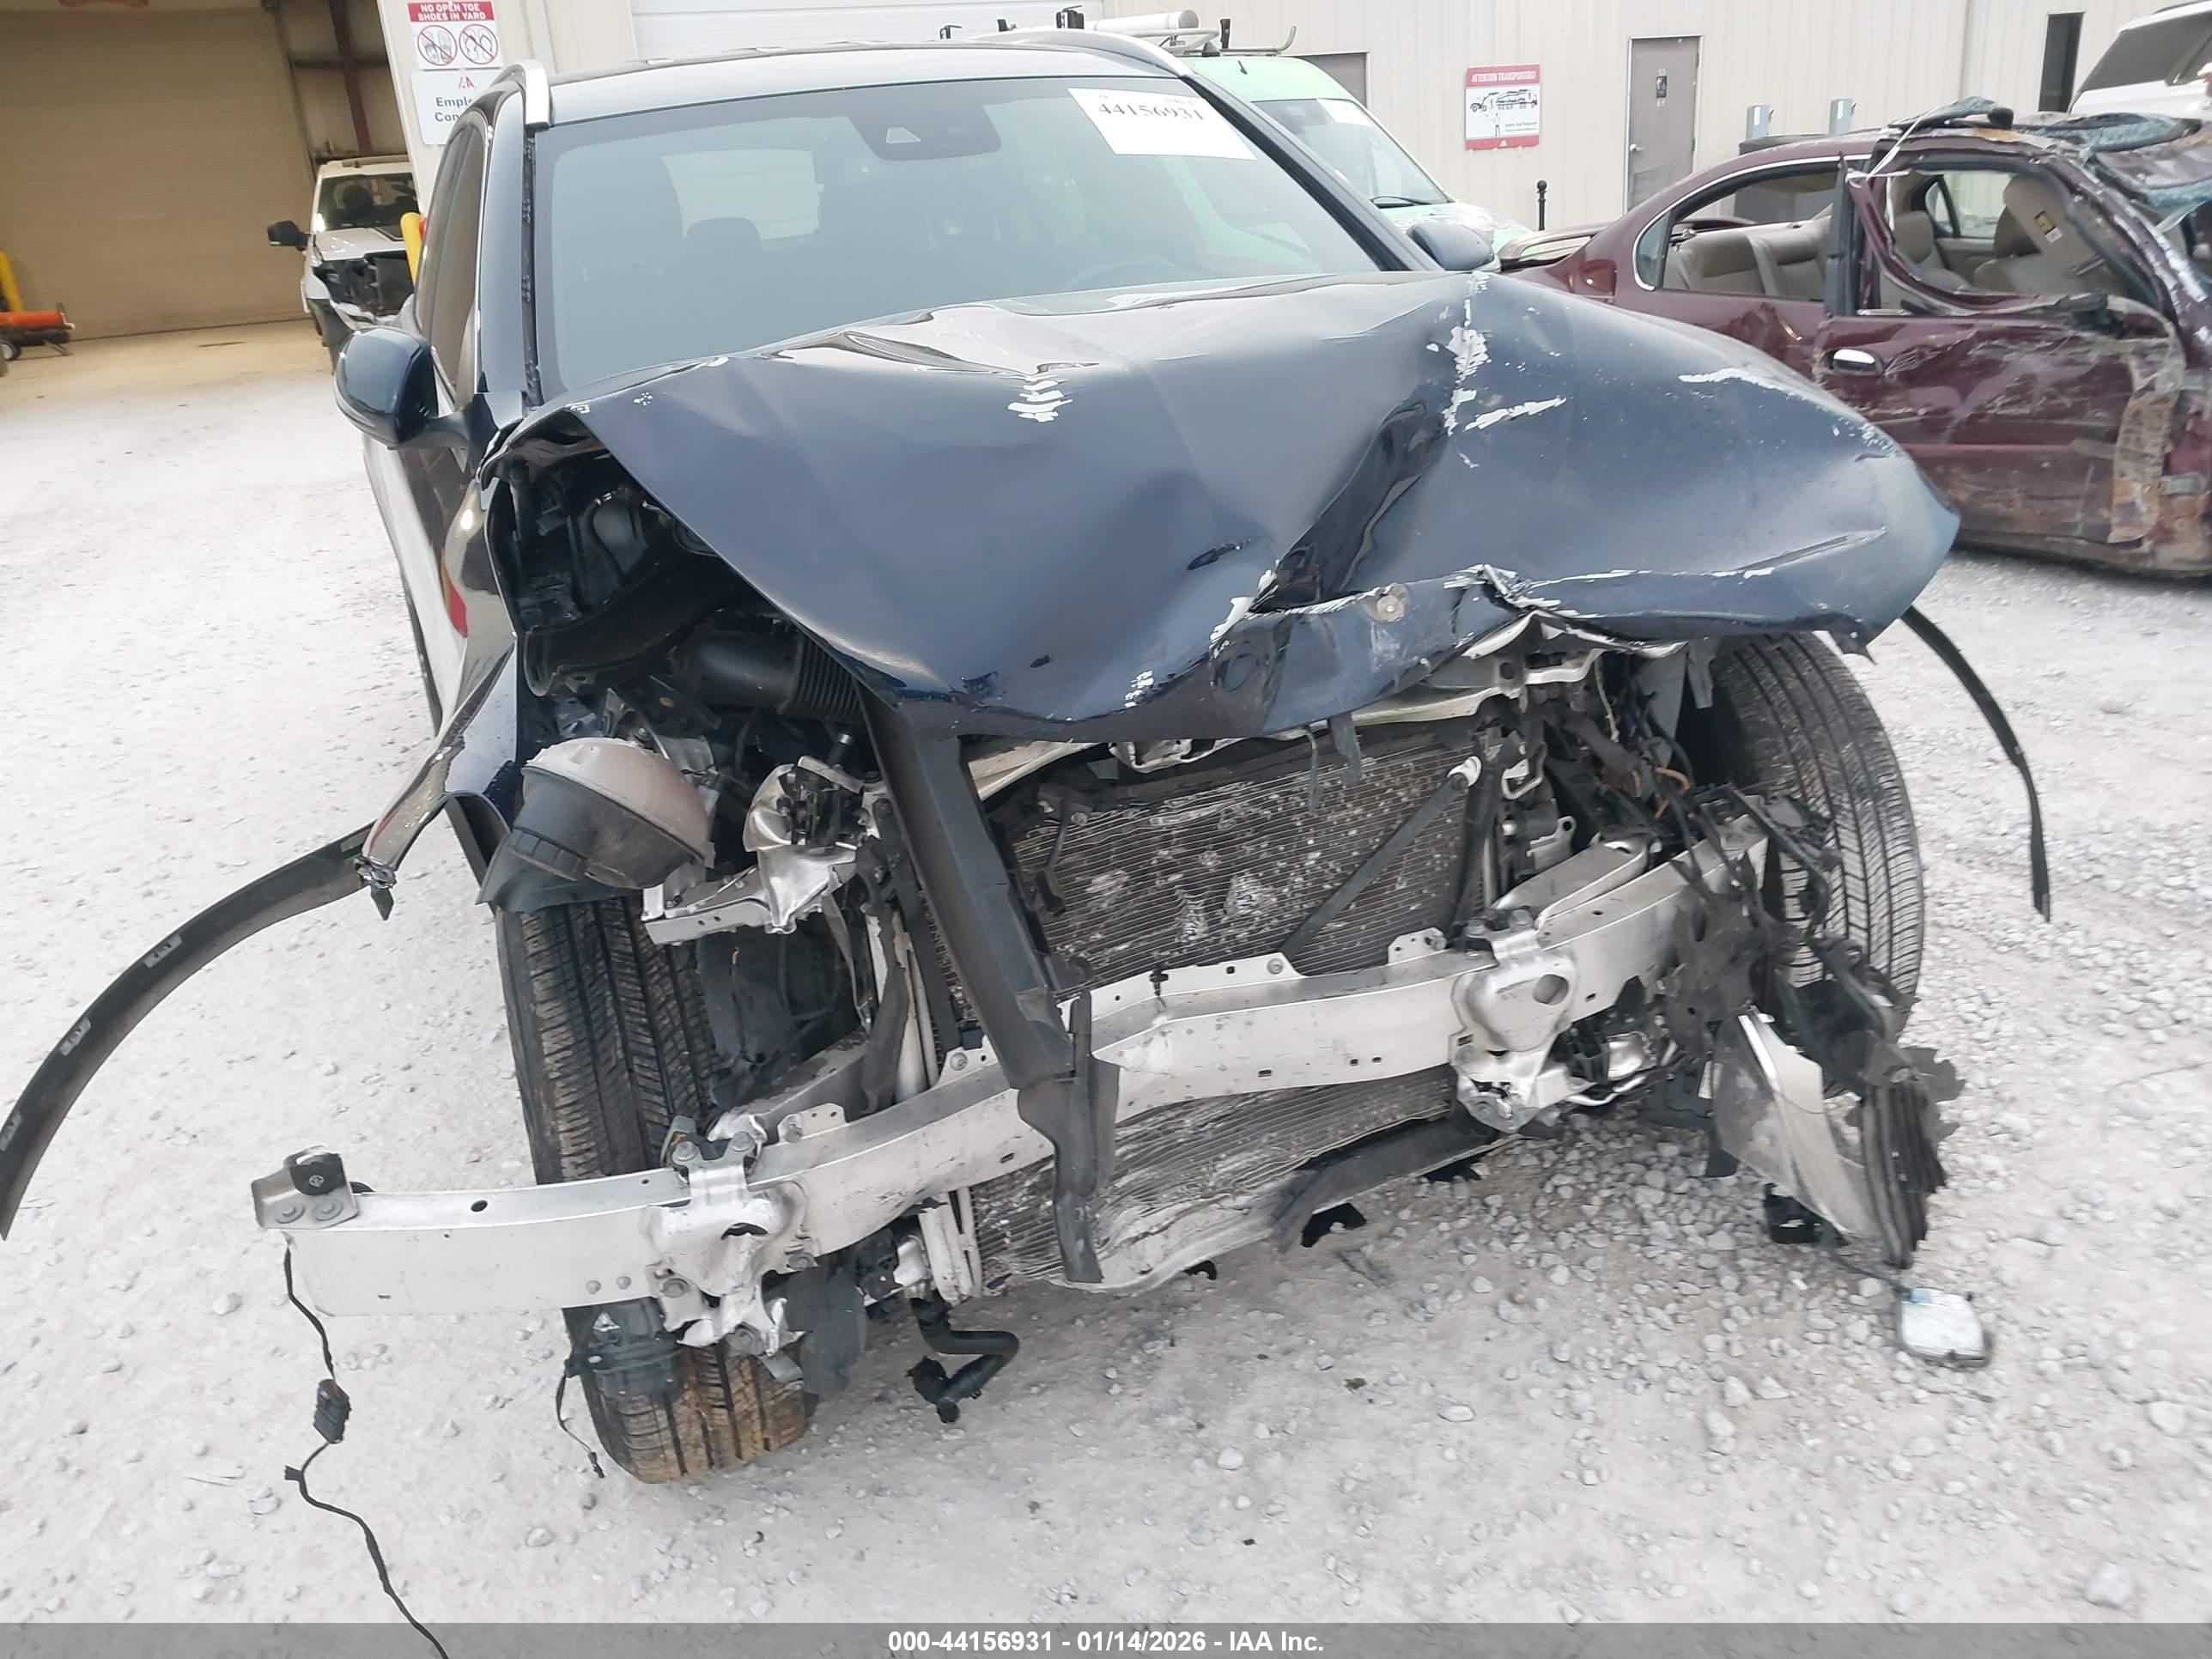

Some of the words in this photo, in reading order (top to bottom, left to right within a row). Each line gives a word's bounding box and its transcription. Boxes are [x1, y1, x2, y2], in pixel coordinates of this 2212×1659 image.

[420, 3, 434, 13] NO
[435, 3, 461, 13] OPEN
[462, 3, 481, 12] TOE
[417, 12, 449, 21] SHOES
[449, 12, 460, 21] IN
[461, 11, 487, 21] YARD
[1099, 102, 1205, 120] 44156931
